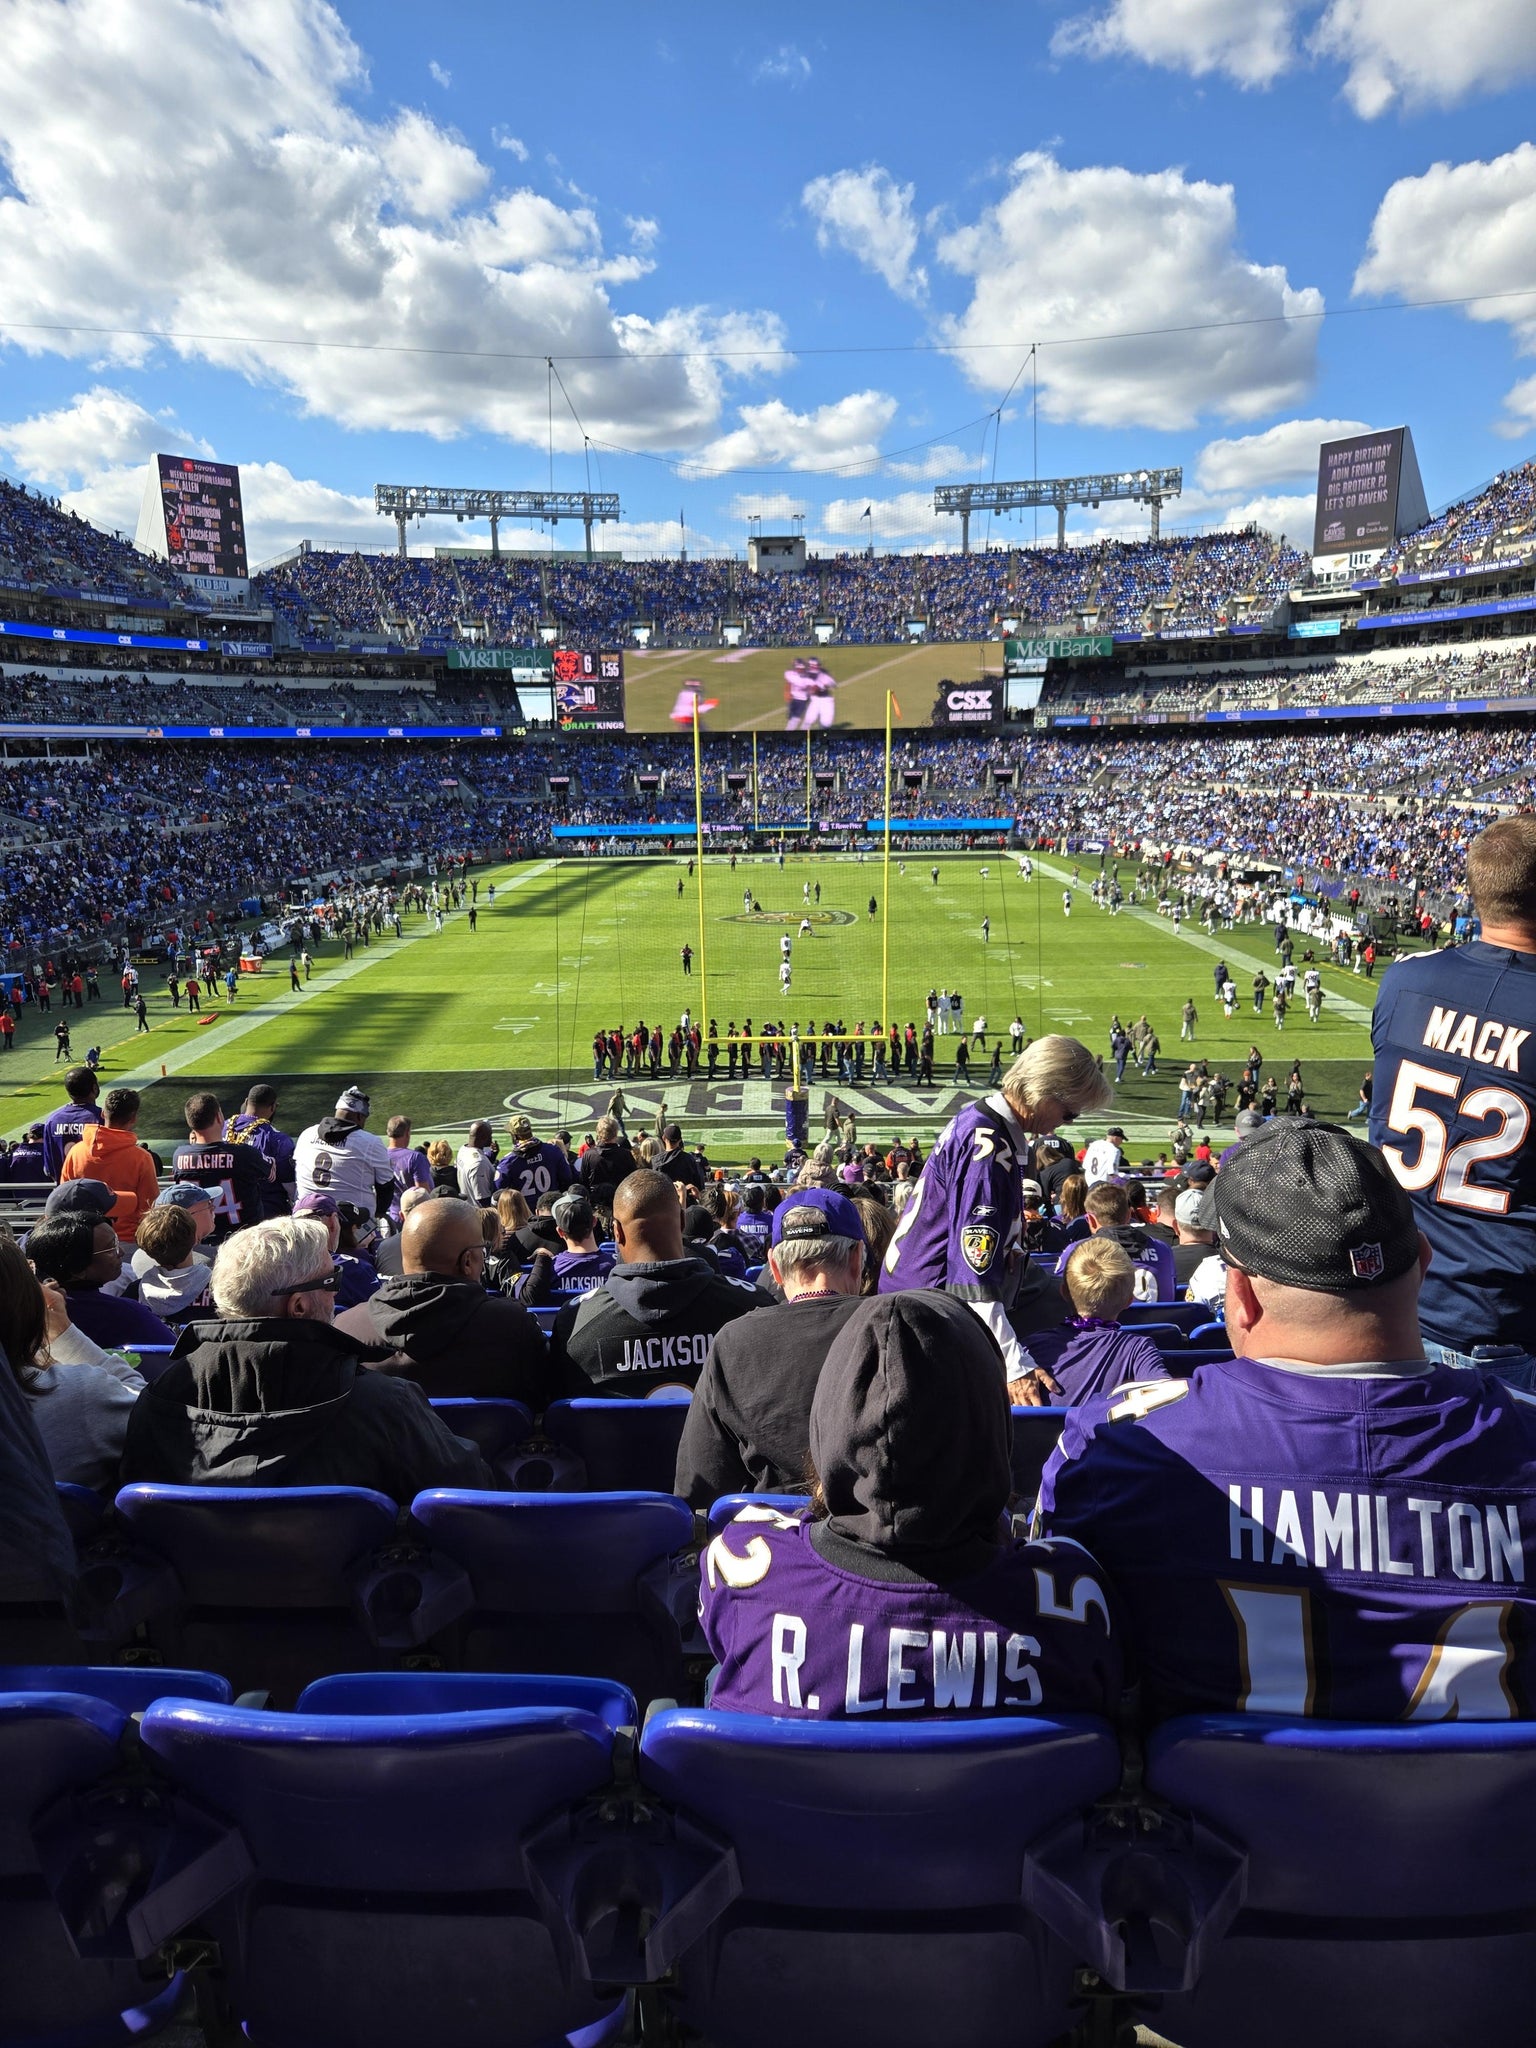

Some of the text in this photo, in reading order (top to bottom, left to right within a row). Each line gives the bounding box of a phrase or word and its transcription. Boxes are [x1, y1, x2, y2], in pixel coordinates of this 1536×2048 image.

[1328, 443, 1392, 467] HAPPY BIRTHDAY
[193, 464, 216, 473] TOYOTA
[1331, 460, 1386, 482] ADIN FROM UR
[182, 481, 200, 493] ALLEN
[188, 472, 213, 485] RECEPTION
[213, 476, 232, 487] LEADERS
[1328, 474, 1387, 496] BIG BROTHER PJ
[1324, 490, 1388, 511] LET'S GO RAVENS
[185, 504, 221, 519] HUTCHINSON
[189, 551, 215, 564] JOHNSON
[196, 579, 229, 591] OLD BAY
[53, 629, 66, 639] CSX
[118, 635, 132, 645] CSX
[186, 640, 200, 649] CSX
[1017, 639, 1102, 657] M&T Bank
[458, 651, 543, 668] M&T Bank
[584, 654, 592, 673] 6
[602, 662, 619, 677] 1:55
[584, 686, 596, 704] 10
[946, 690, 993, 711] CSX
[949, 712, 962, 721] GAME
[209, 727, 224, 737] CSX
[296, 728, 311, 736] CSX
[388, 728, 403, 736] CSX
[481, 728, 496, 736] CSX
[562, 721, 624, 731] DRAFTKINGS
[1422, 1005, 1532, 1073] MACK
[54, 1124, 84, 1135] JACKSO
[1381, 1058, 1531, 1215] 52
[972, 1127, 1013, 1173] 52
[177, 1154, 234, 1170] URLACHER
[1090, 1157, 1099, 1175] 8
[312, 1152, 333, 1188] 8
[520, 1165, 551, 1197] 20
[786, 1227, 814, 1235] RAVENS
[1357, 1258, 1381, 1275] NFL
[558, 1277, 605, 1291] JACKSON
[1229, 1485, 1525, 1583] HAMILTON
[771, 1613, 1043, 1713] R. LEWIS
